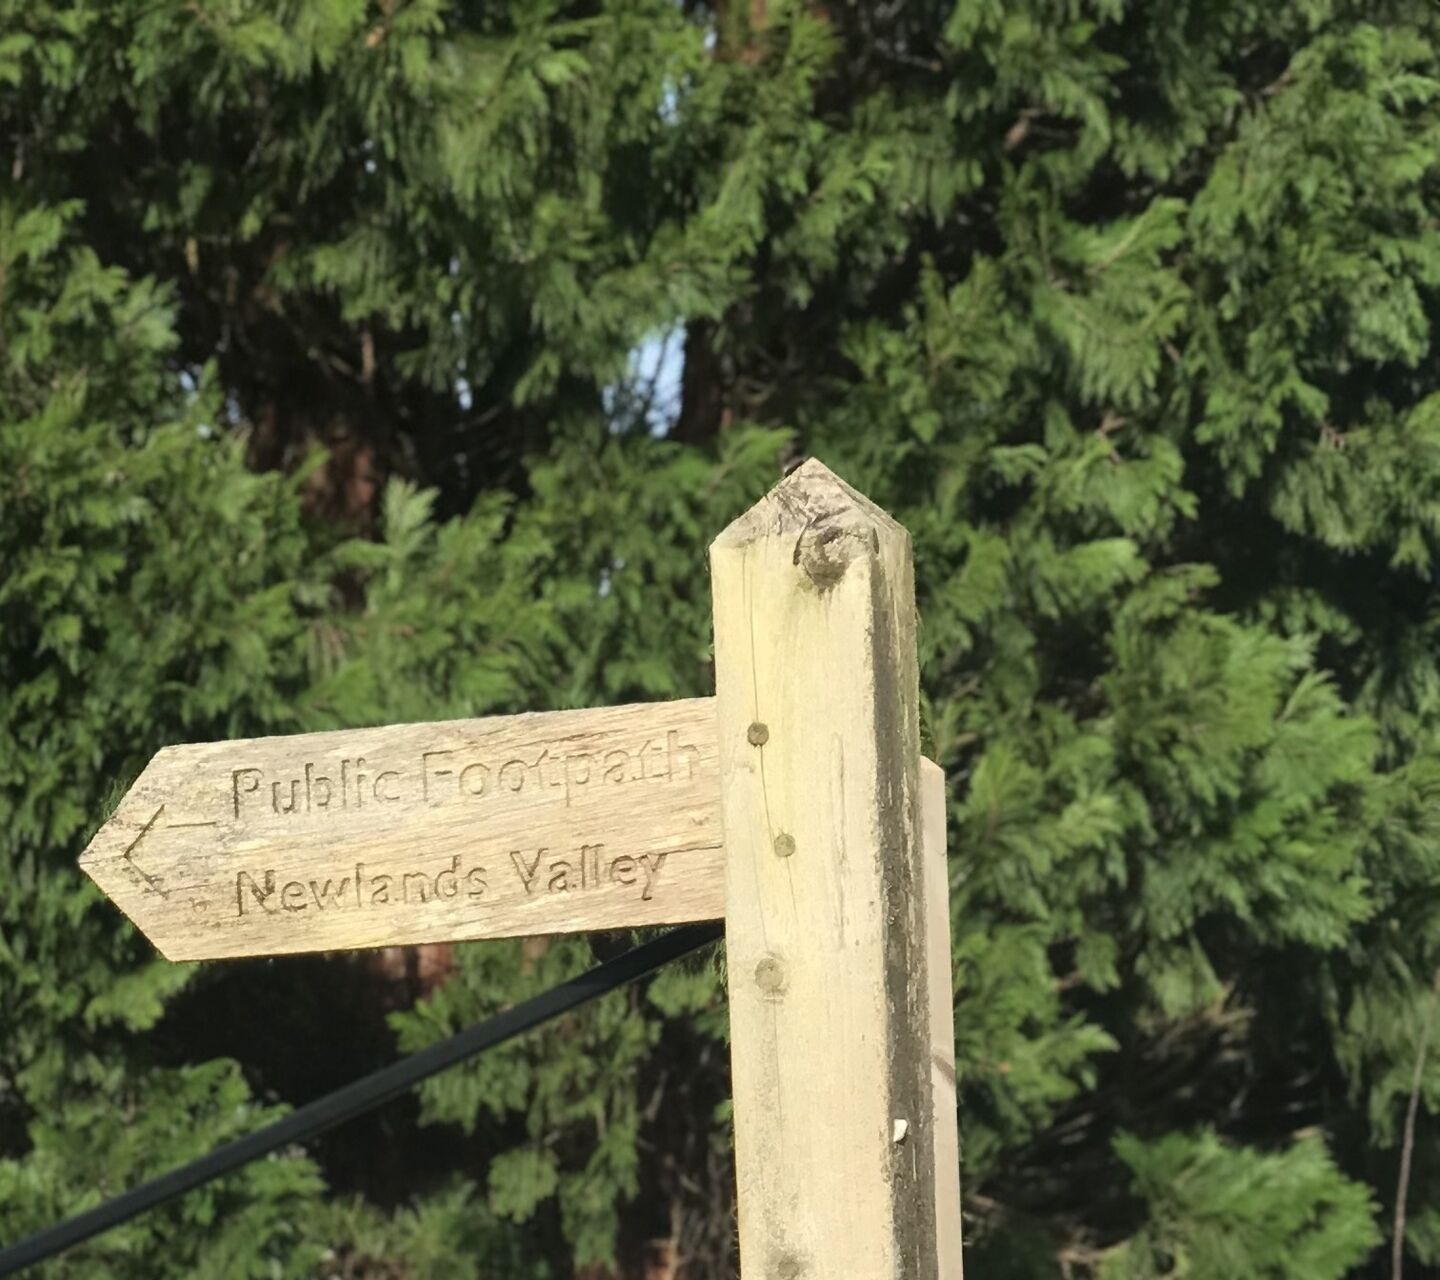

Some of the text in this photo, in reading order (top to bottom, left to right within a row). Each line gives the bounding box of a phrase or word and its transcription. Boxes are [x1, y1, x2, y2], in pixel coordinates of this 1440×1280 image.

[232, 729, 701, 819] Public Footpath
[235, 843, 668, 918] Newlands Valley
